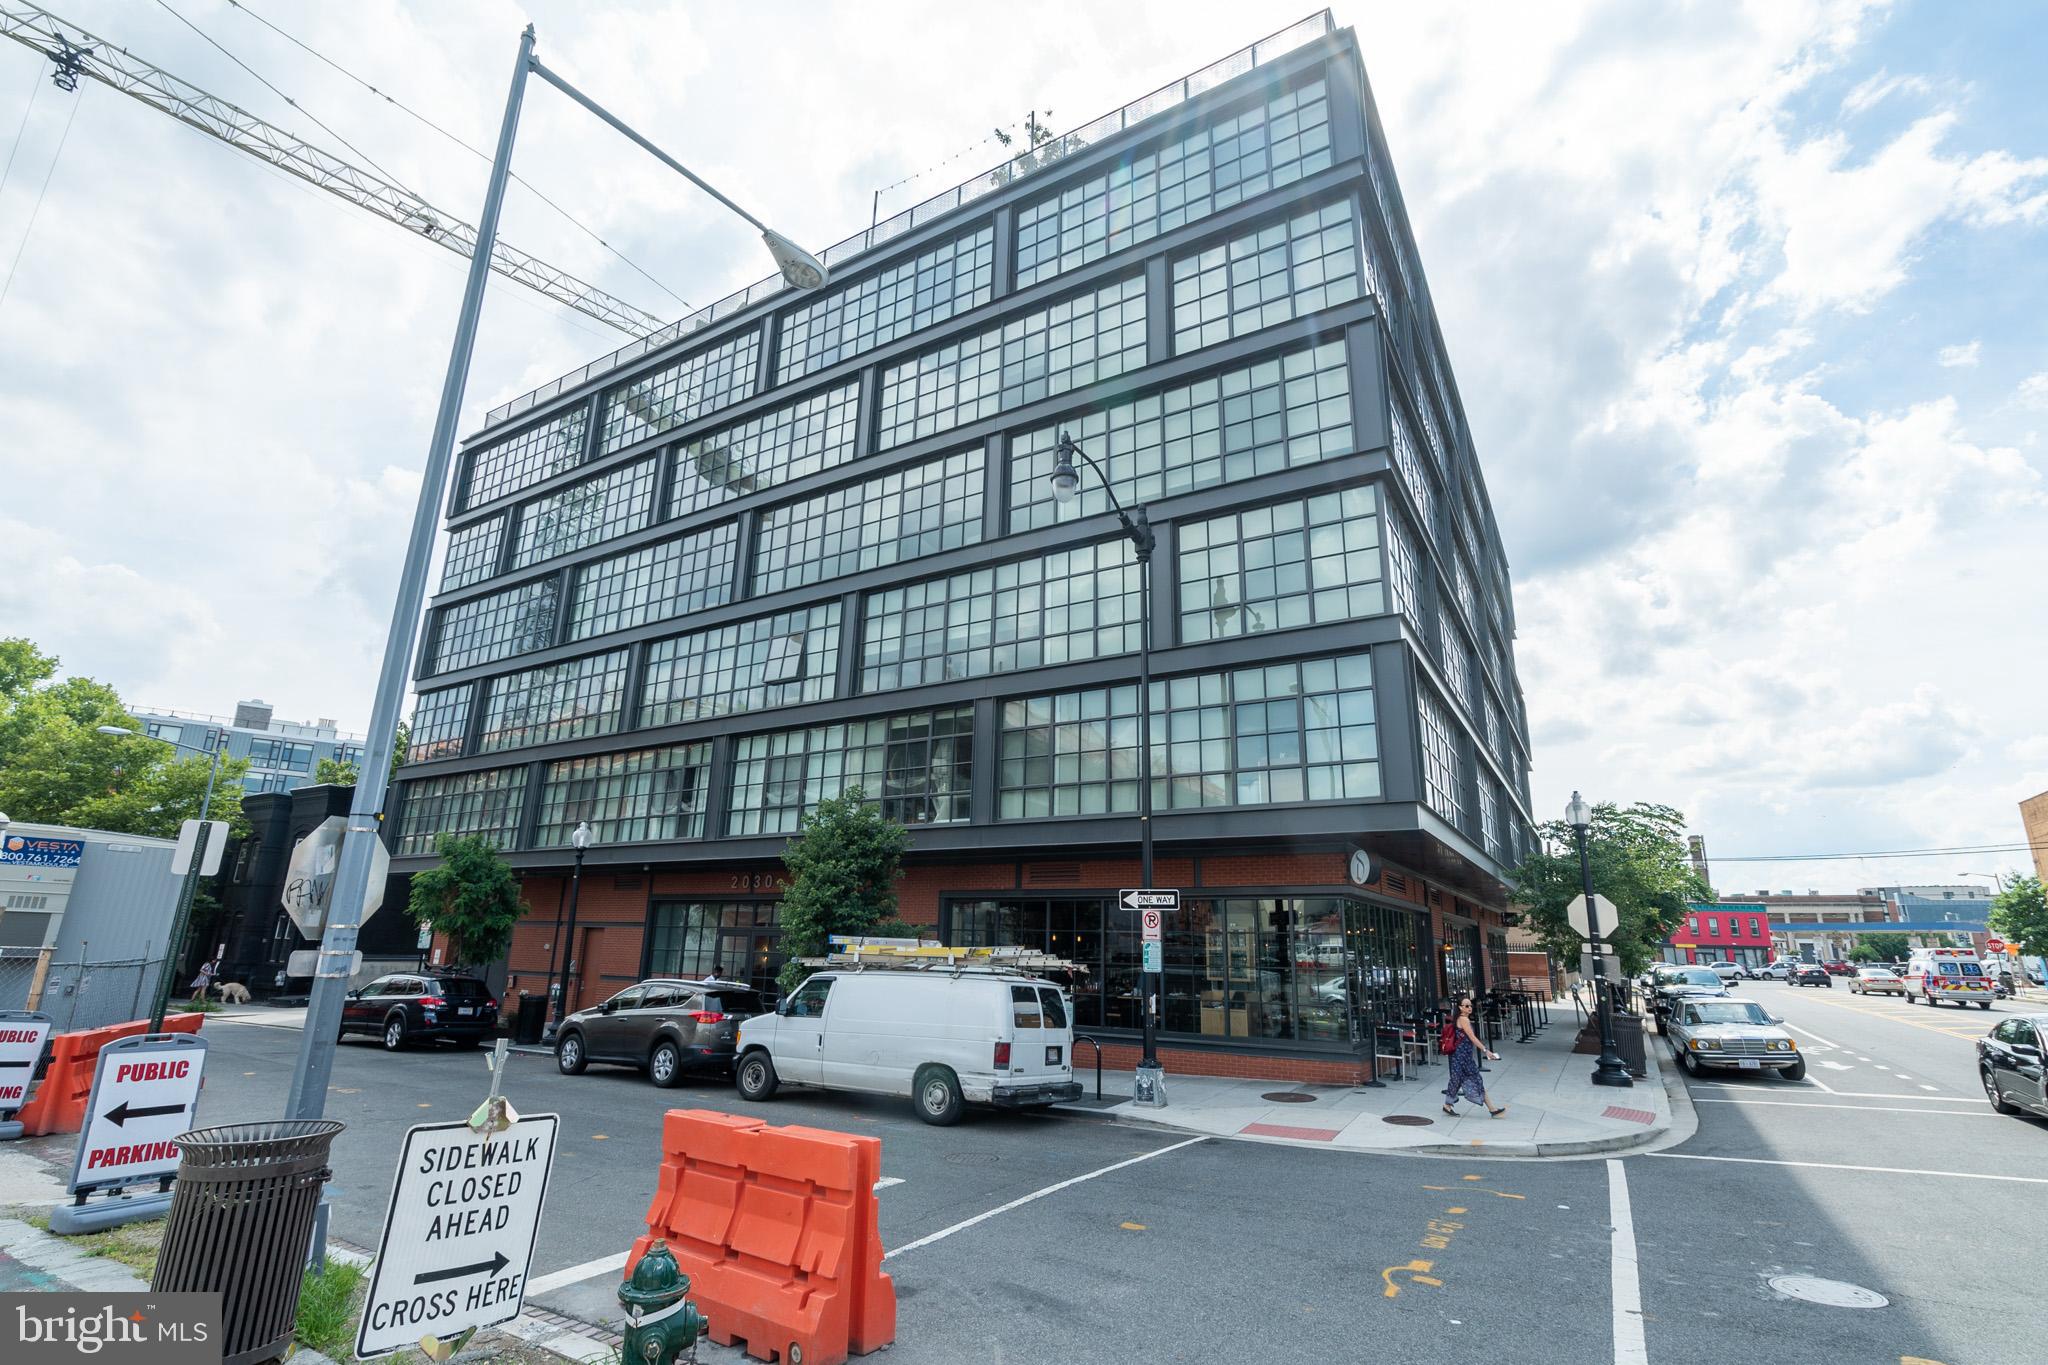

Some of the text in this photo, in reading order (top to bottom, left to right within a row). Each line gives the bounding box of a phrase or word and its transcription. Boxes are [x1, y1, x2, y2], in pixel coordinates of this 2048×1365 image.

[26, 840, 80, 851] VESTA
[731, 875, 773, 889] 2030
[0, 1030, 38, 1043] UBLIC
[116, 1060, 190, 1083] PUBLIC
[87, 1141, 179, 1170] PARKING
[420, 1137, 539, 1174] SIDEWALK
[426, 1171, 522, 1207] CLOSED
[425, 1205, 510, 1242] AHEAD
[372, 1273, 522, 1331] CROSS HERE
